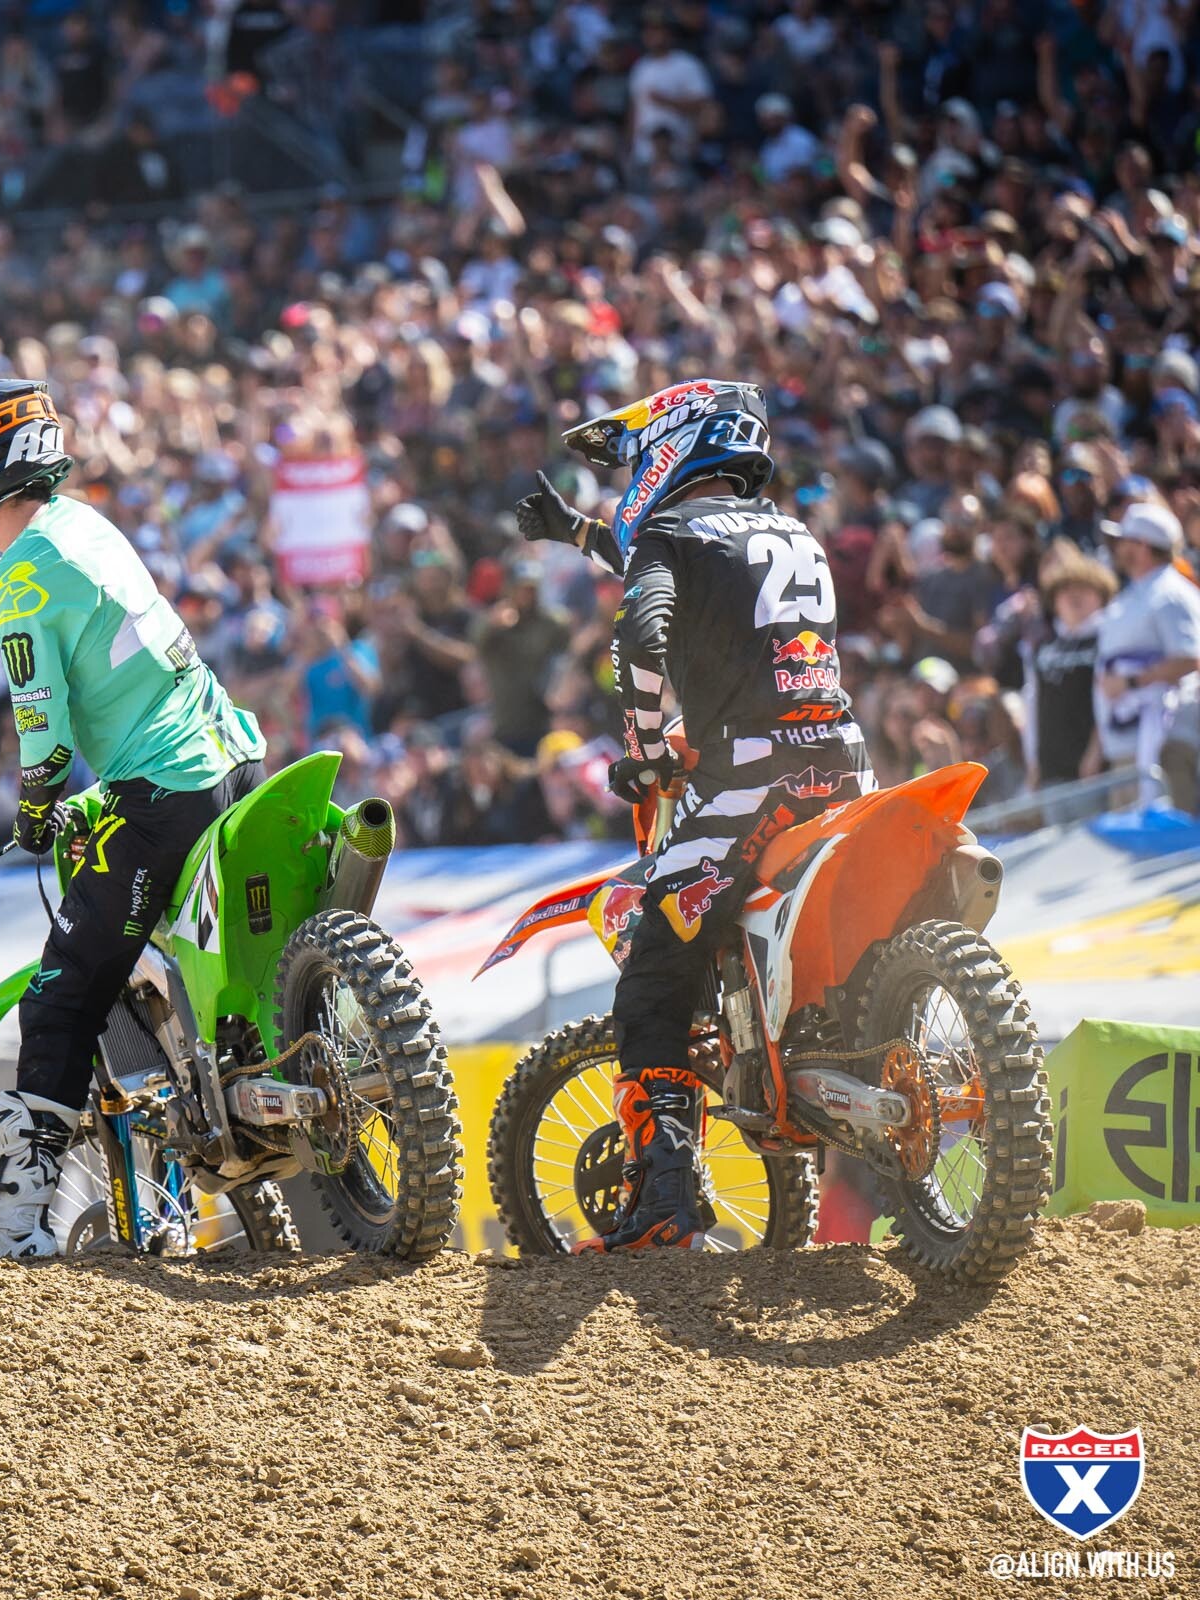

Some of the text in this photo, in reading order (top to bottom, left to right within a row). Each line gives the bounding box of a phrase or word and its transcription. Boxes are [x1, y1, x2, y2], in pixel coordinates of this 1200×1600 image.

[639, 396, 718, 451] 100%
[747, 533, 837, 629] 25
[774, 666, 812, 692] Red
[19, 713, 46, 733] GREEN
[770, 723, 831, 745] THOR
[549, 897, 580, 917] Bull
